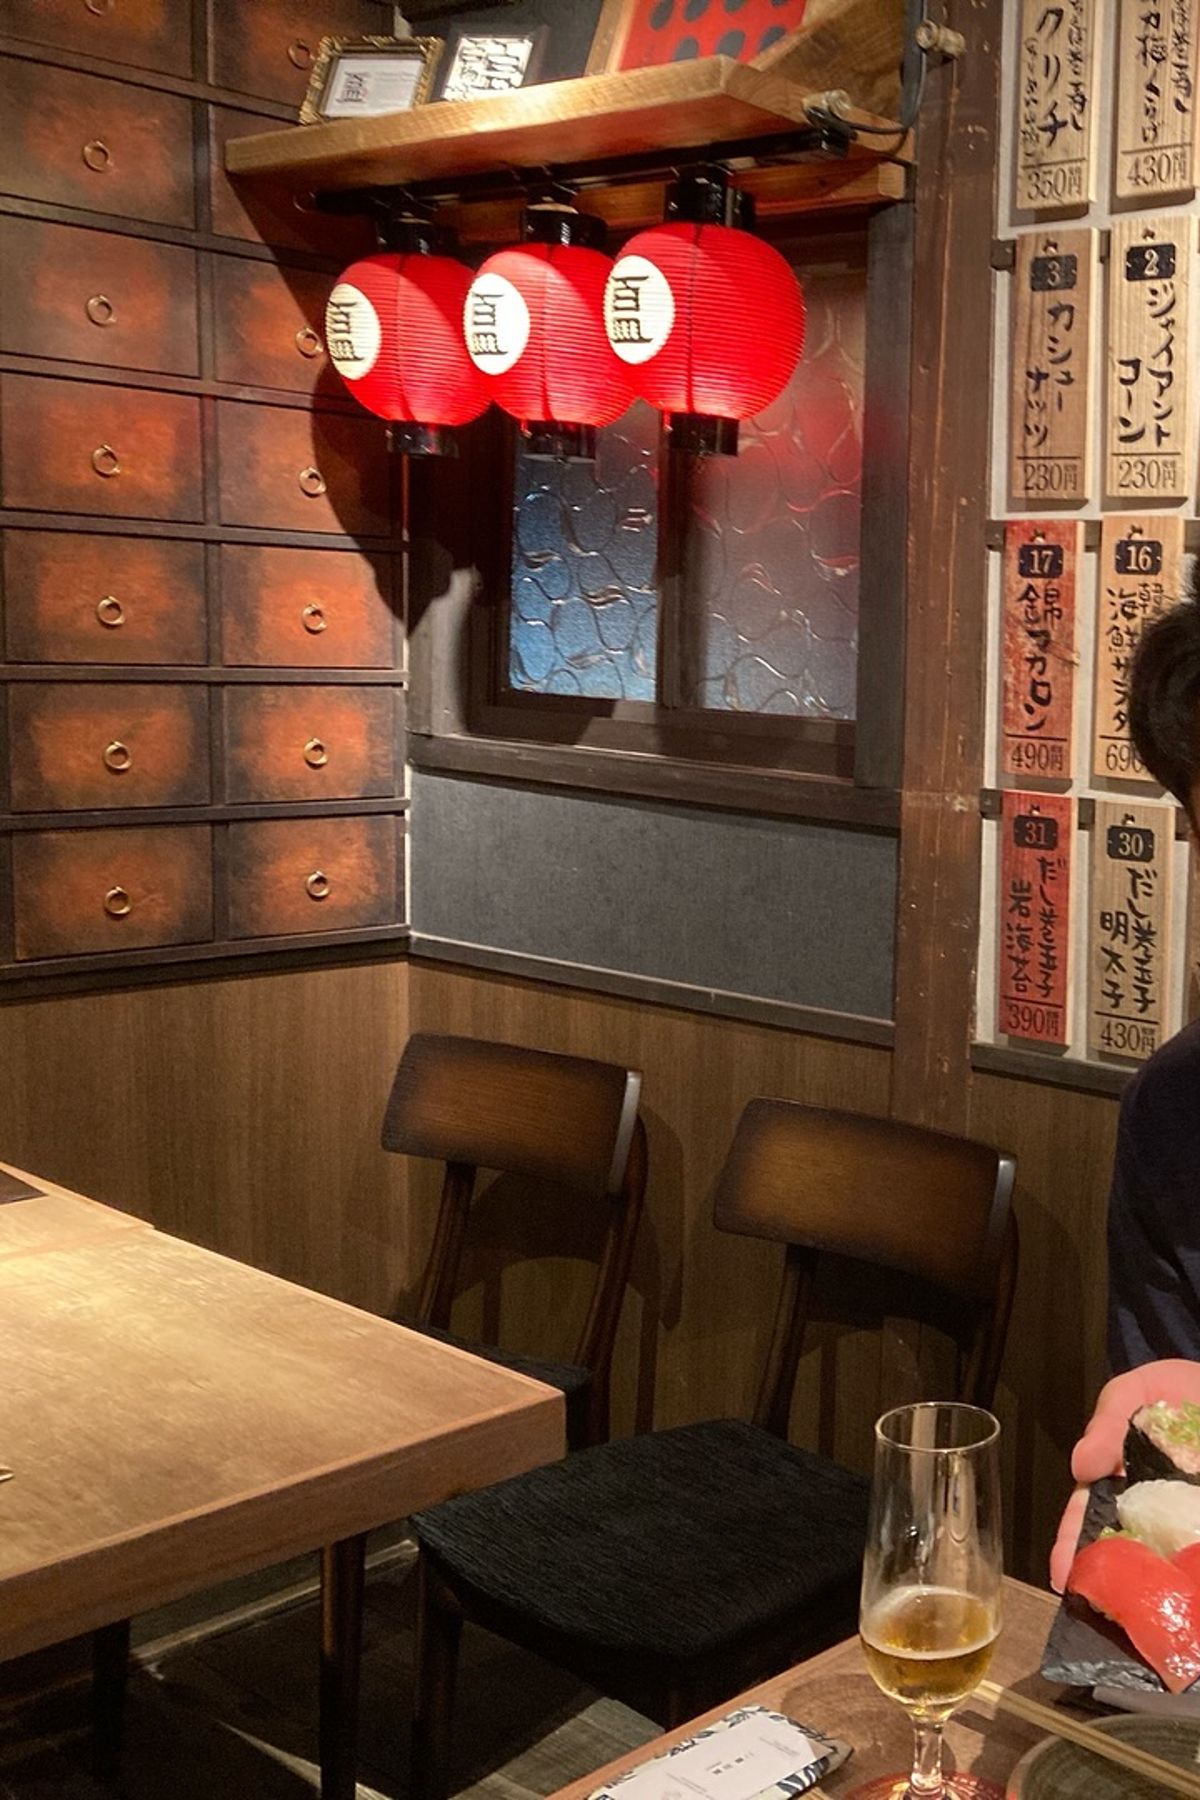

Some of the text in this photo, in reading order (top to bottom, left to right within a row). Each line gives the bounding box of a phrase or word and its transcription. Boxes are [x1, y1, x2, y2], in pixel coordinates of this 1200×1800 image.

[1144, 249, 1159, 277] 2
[1047, 301, 1074, 412] カシュー
[1147, 282, 1176, 448] ジャイアント
[1024, 365, 1049, 448] ナッツ
[1118, 357, 1145, 443] コーン
[1030, 551, 1053, 574] 17
[1126, 545, 1152, 571] 16
[1025, 822, 1047, 845] 31
[1118, 832, 1143, 857] 30
[1100, 911, 1129, 1010] 明太子
